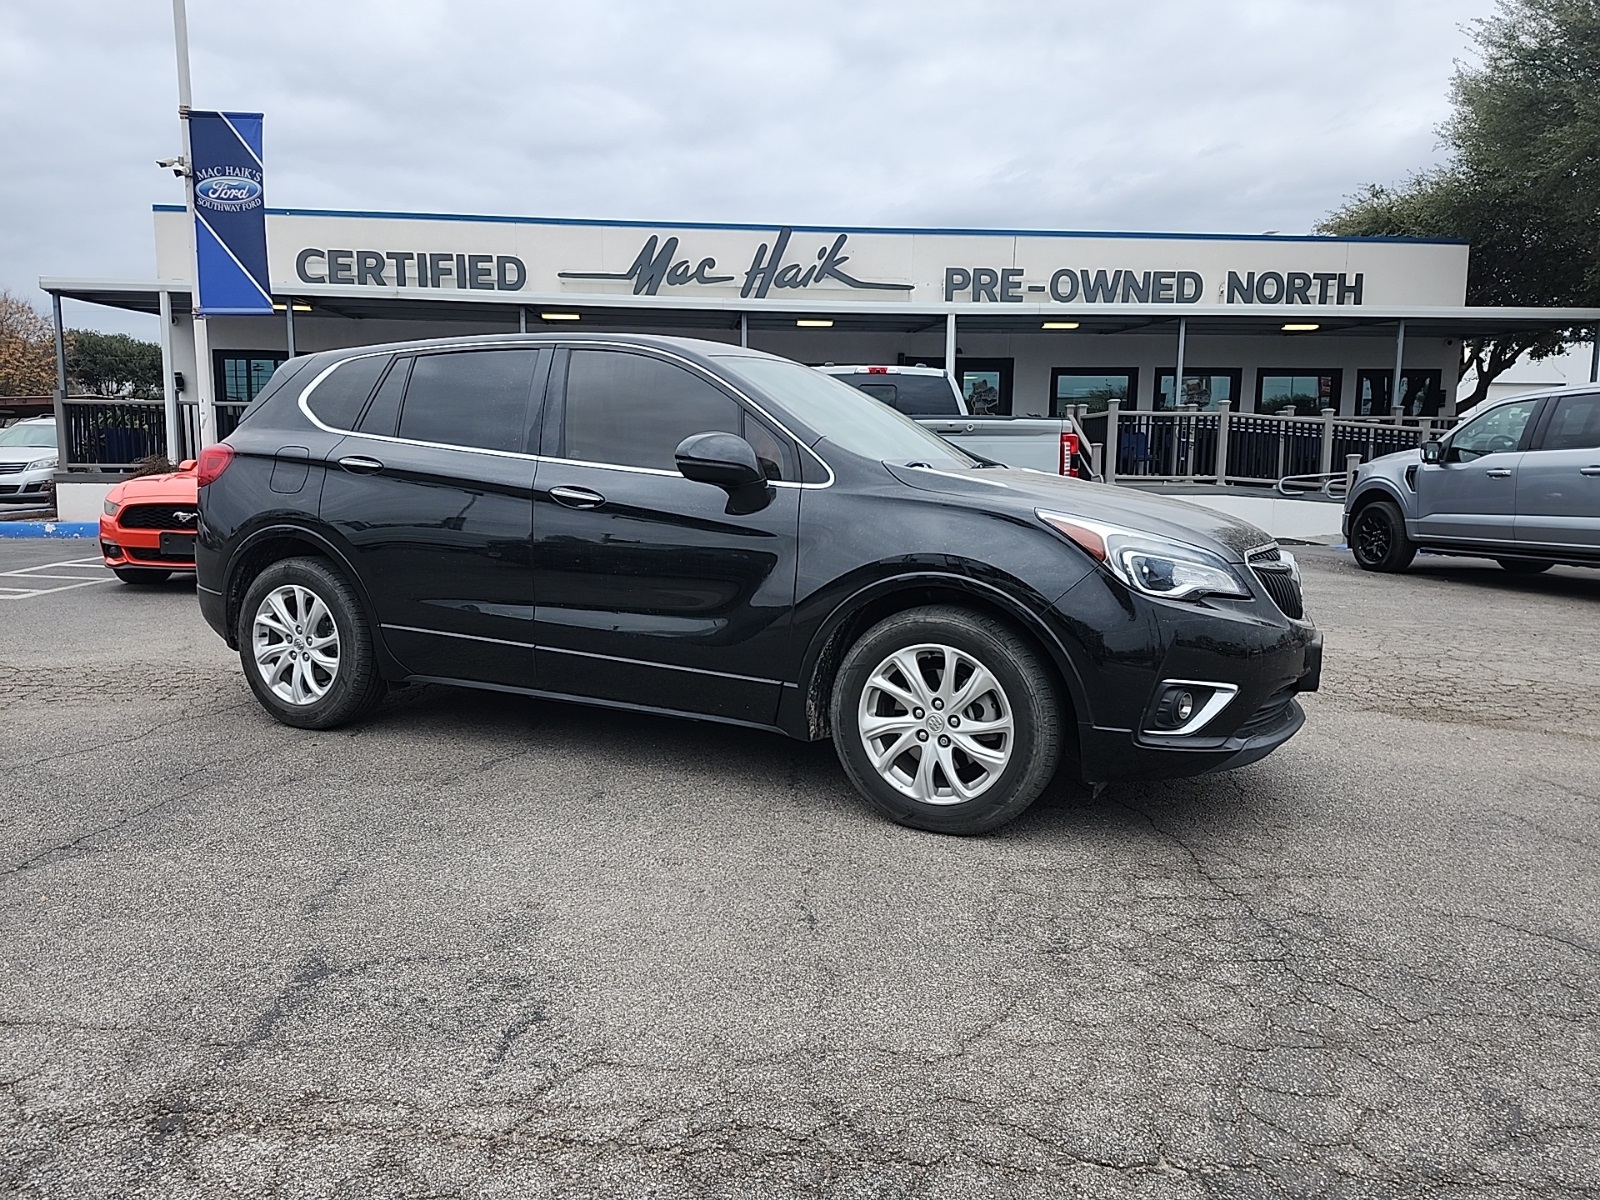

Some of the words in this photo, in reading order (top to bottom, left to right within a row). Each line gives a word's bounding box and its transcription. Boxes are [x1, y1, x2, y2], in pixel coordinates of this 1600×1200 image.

[196, 166, 222, 180] MAC
[225, 166, 262, 182] HAIK'S
[208, 180, 250, 199] Ford
[196, 197, 241, 212] SOUTHWAY
[242, 198, 262, 211] FORD
[295, 247, 527, 292] CERTIFIED
[557, 234, 735, 296] Mac
[739, 226, 915, 299] Haik
[943, 267, 1204, 304] PRE-OWNED
[1226, 270, 1364, 306] NORTH
